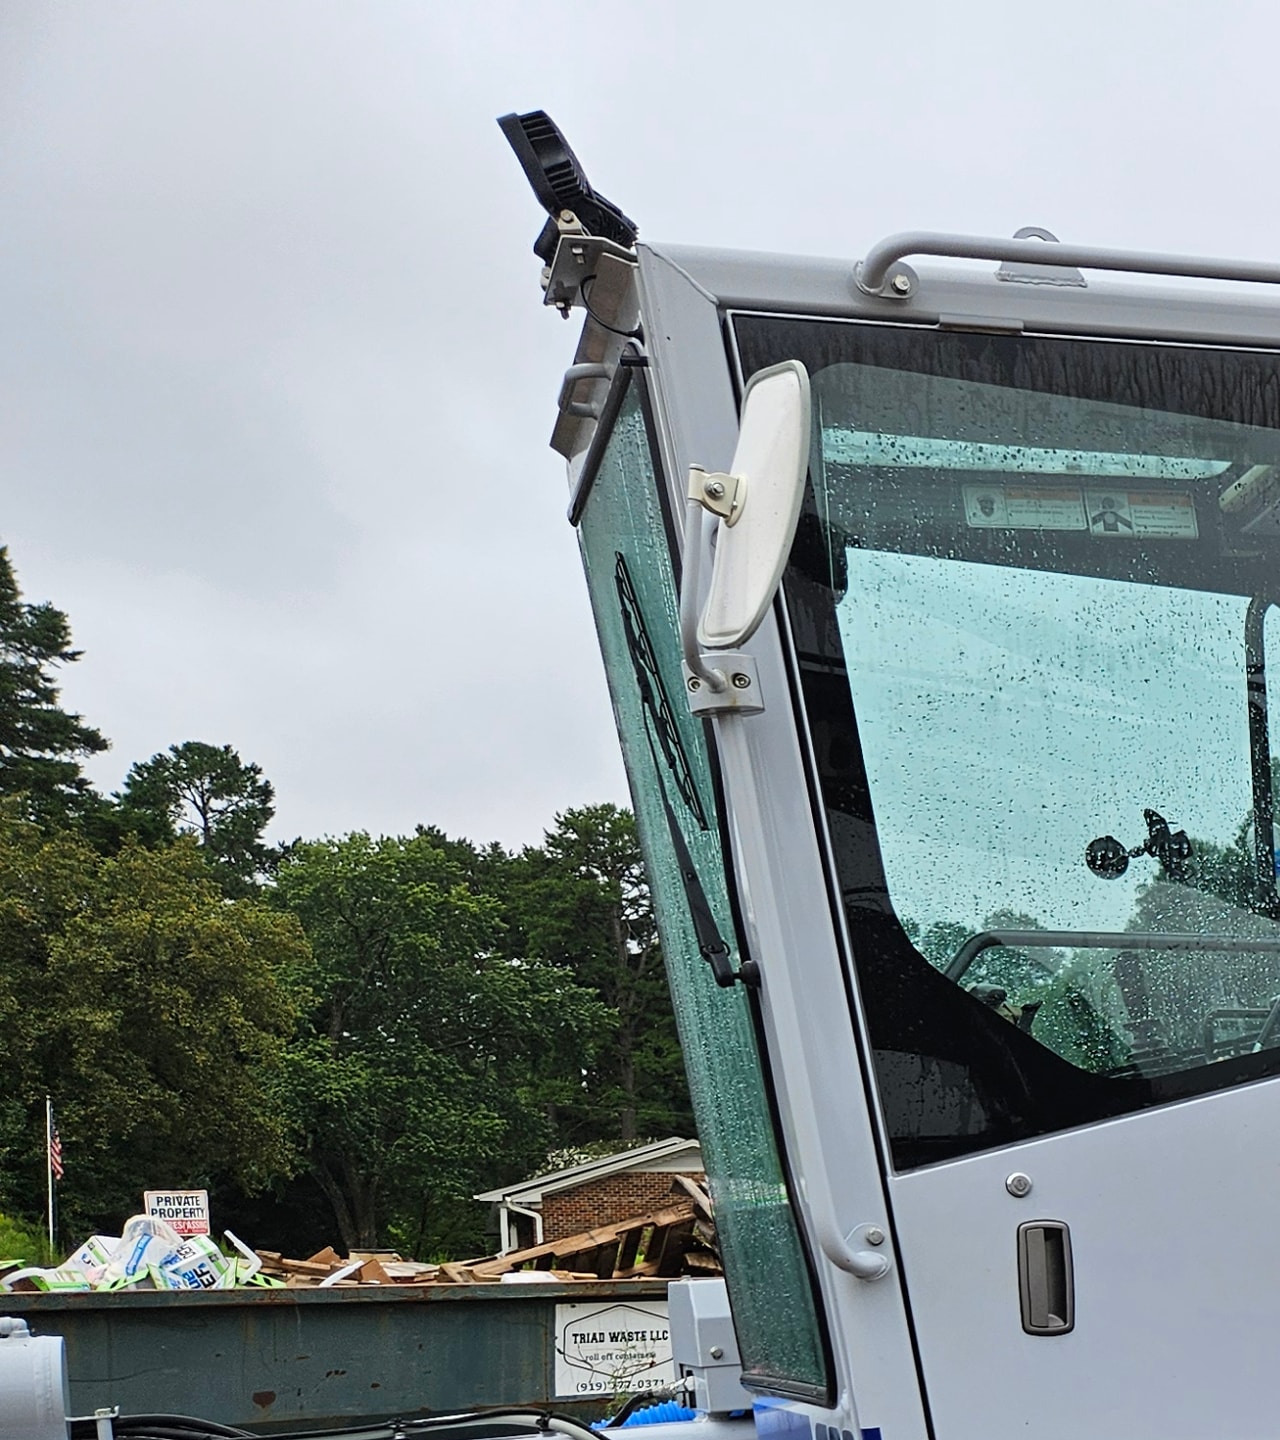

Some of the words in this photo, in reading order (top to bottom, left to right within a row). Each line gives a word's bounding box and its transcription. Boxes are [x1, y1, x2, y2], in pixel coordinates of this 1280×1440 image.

[156, 1195, 201, 1206] PRIVATE
[151, 1207, 205, 1218] PROPERTY
[572, 1332, 605, 1344] TRIAD
[609, 1331, 647, 1343] WASTE
[650, 1330, 669, 1341] LLC
[585, 1353, 599, 1361] roll
[601, 1352, 613, 1360] off
[576, 1381, 606, 1392] (919)
